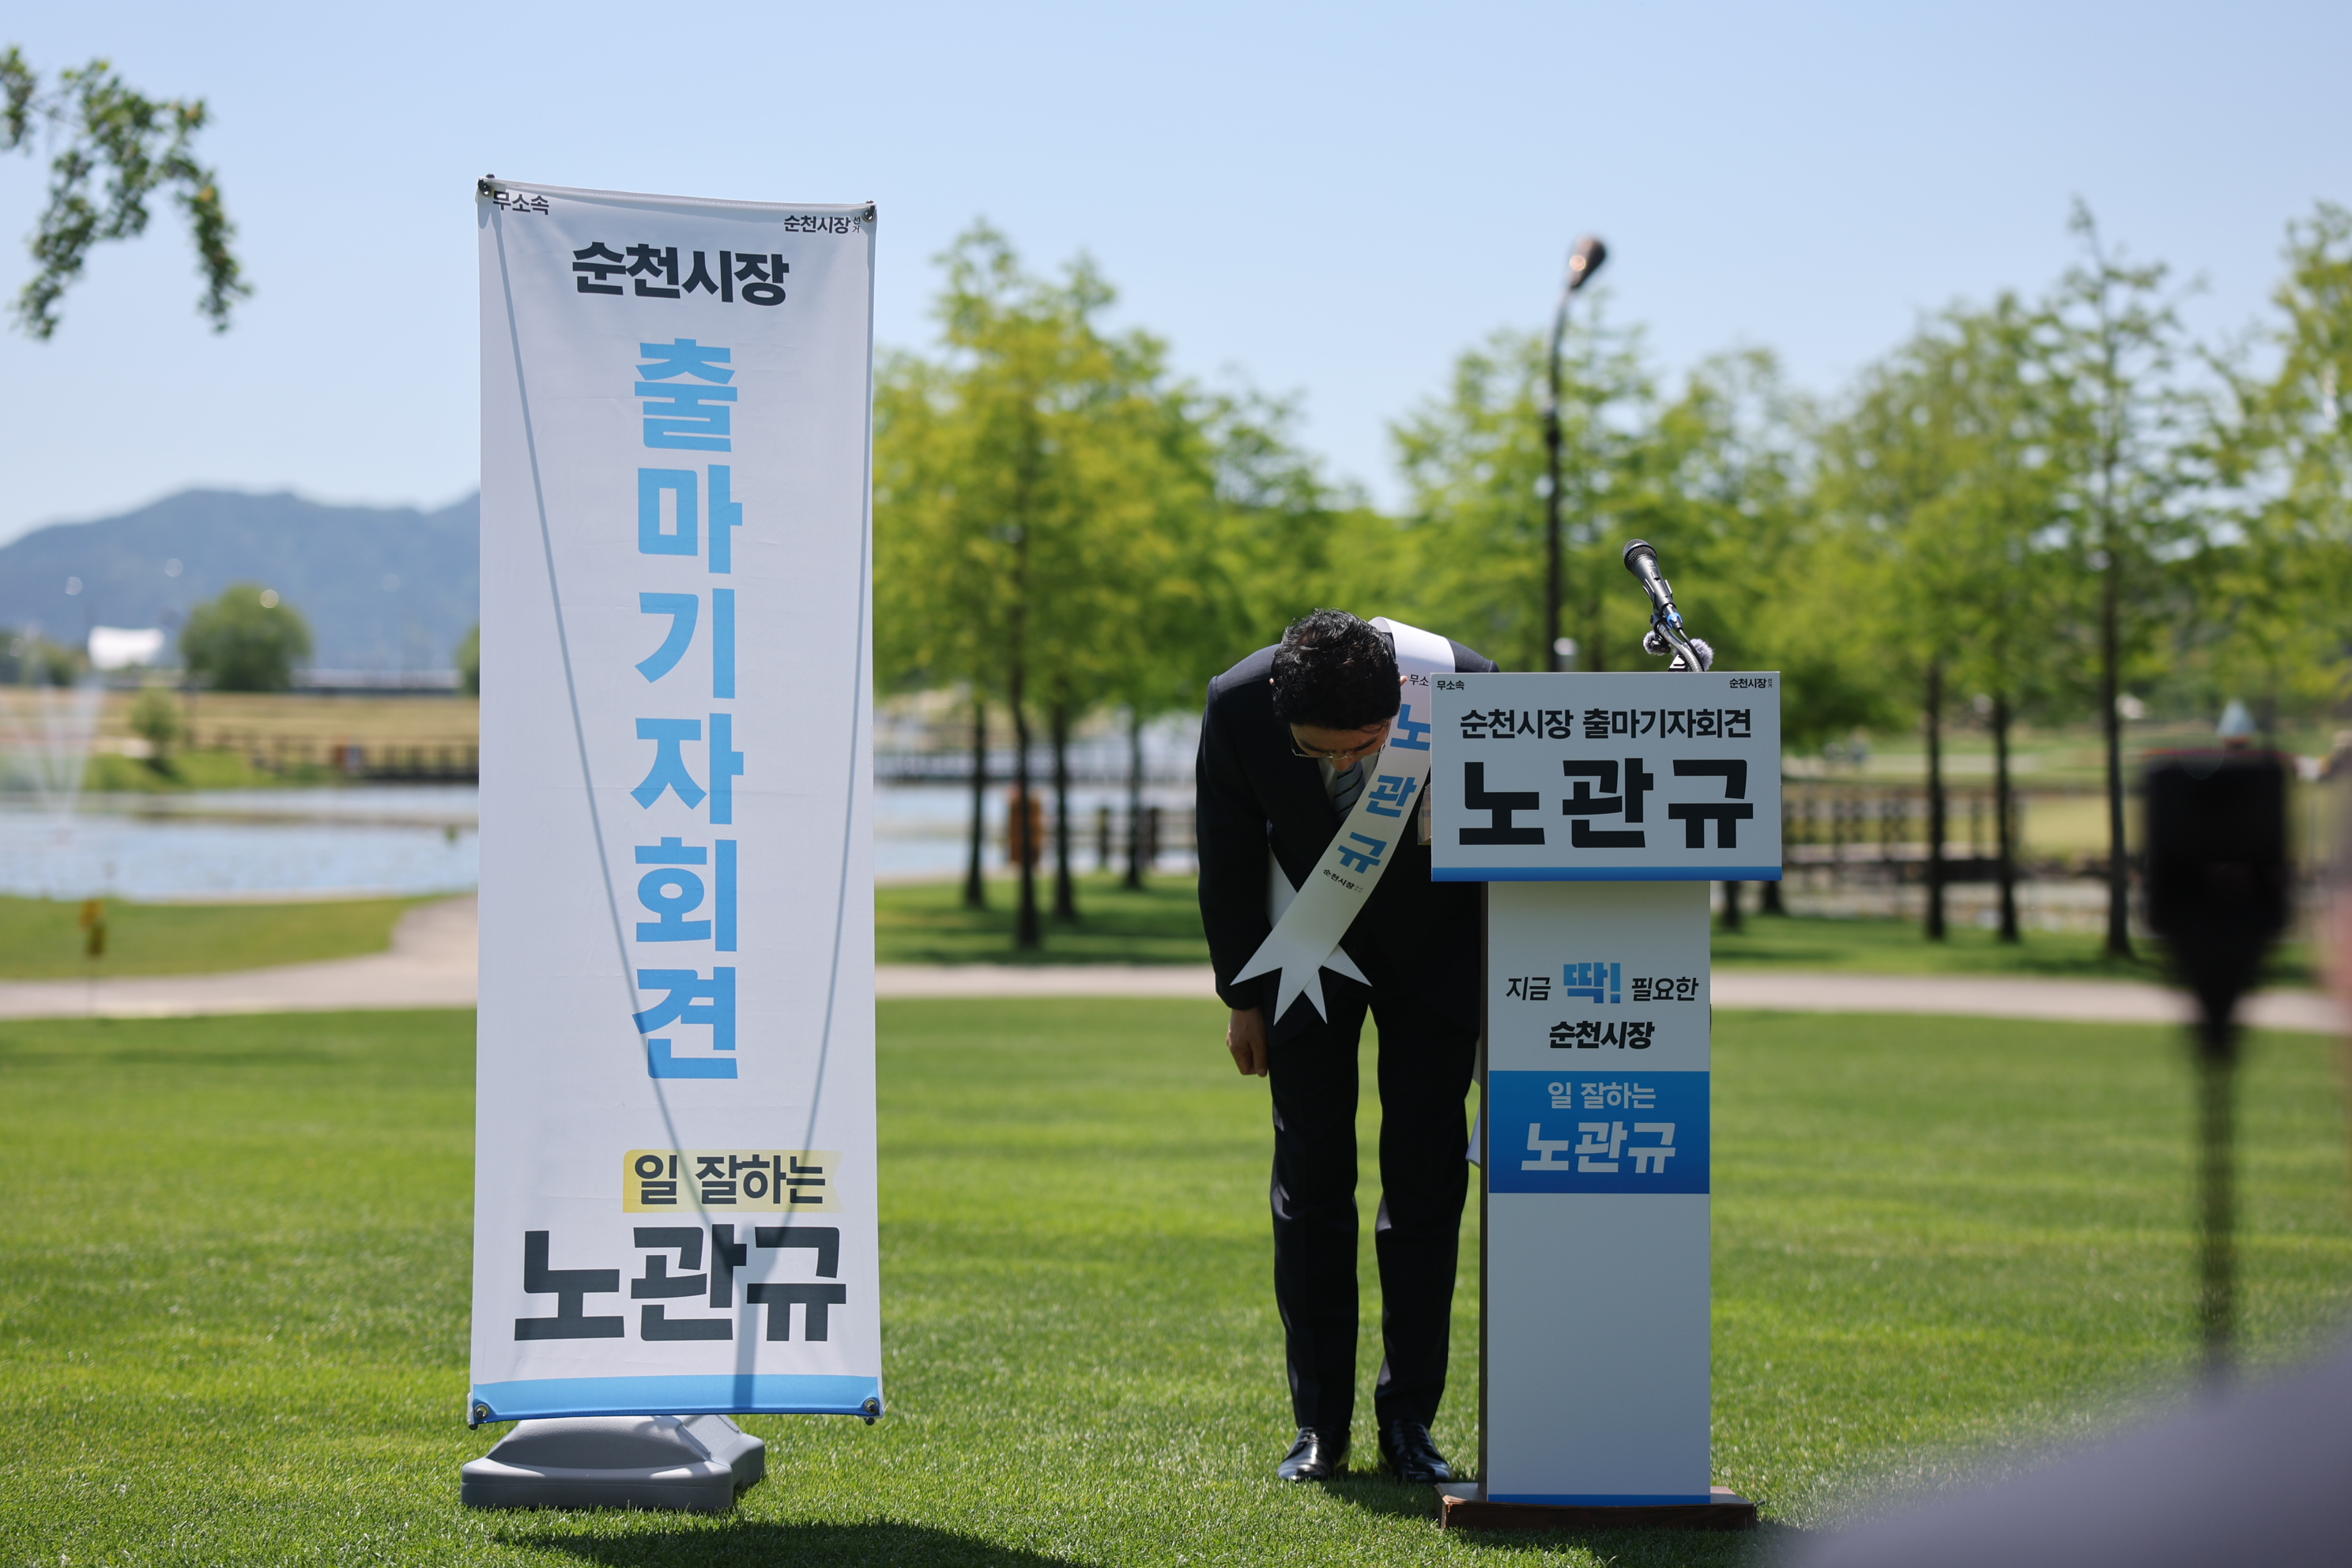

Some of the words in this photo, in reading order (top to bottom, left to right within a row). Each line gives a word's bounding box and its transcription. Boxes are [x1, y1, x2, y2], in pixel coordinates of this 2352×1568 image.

[492, 190, 549, 216] 무소속
[783, 215, 851, 235] 순천시장
[852, 216, 861, 234] 선거
[573, 242, 789, 306] 순천시장
[1409, 674, 1430, 687] 무소
[1438, 680, 1464, 690] 무소속
[1729, 677, 1766, 688] 순천시장
[631, 338, 744, 1079] 출마기자회견
[1461, 709, 1574, 739] 순천시장
[1583, 709, 1751, 738] 출마기자회견
[1460, 758, 1753, 848] 노관규
[1323, 869, 1355, 890] 순천시장
[1506, 977, 1551, 1001] 지금
[1564, 963, 1621, 1003] 딱!
[1632, 977, 1698, 1001] 필요한
[1550, 1021, 1655, 1049] 순천시장
[1548, 1082, 1571, 1108] 일
[1581, 1082, 1656, 1109] 잘하는
[1521, 1121, 1675, 1173] 노관규
[635, 1155, 677, 1204] 일
[695, 1155, 825, 1204] 잘하는
[514, 1224, 846, 1341] 노관규
